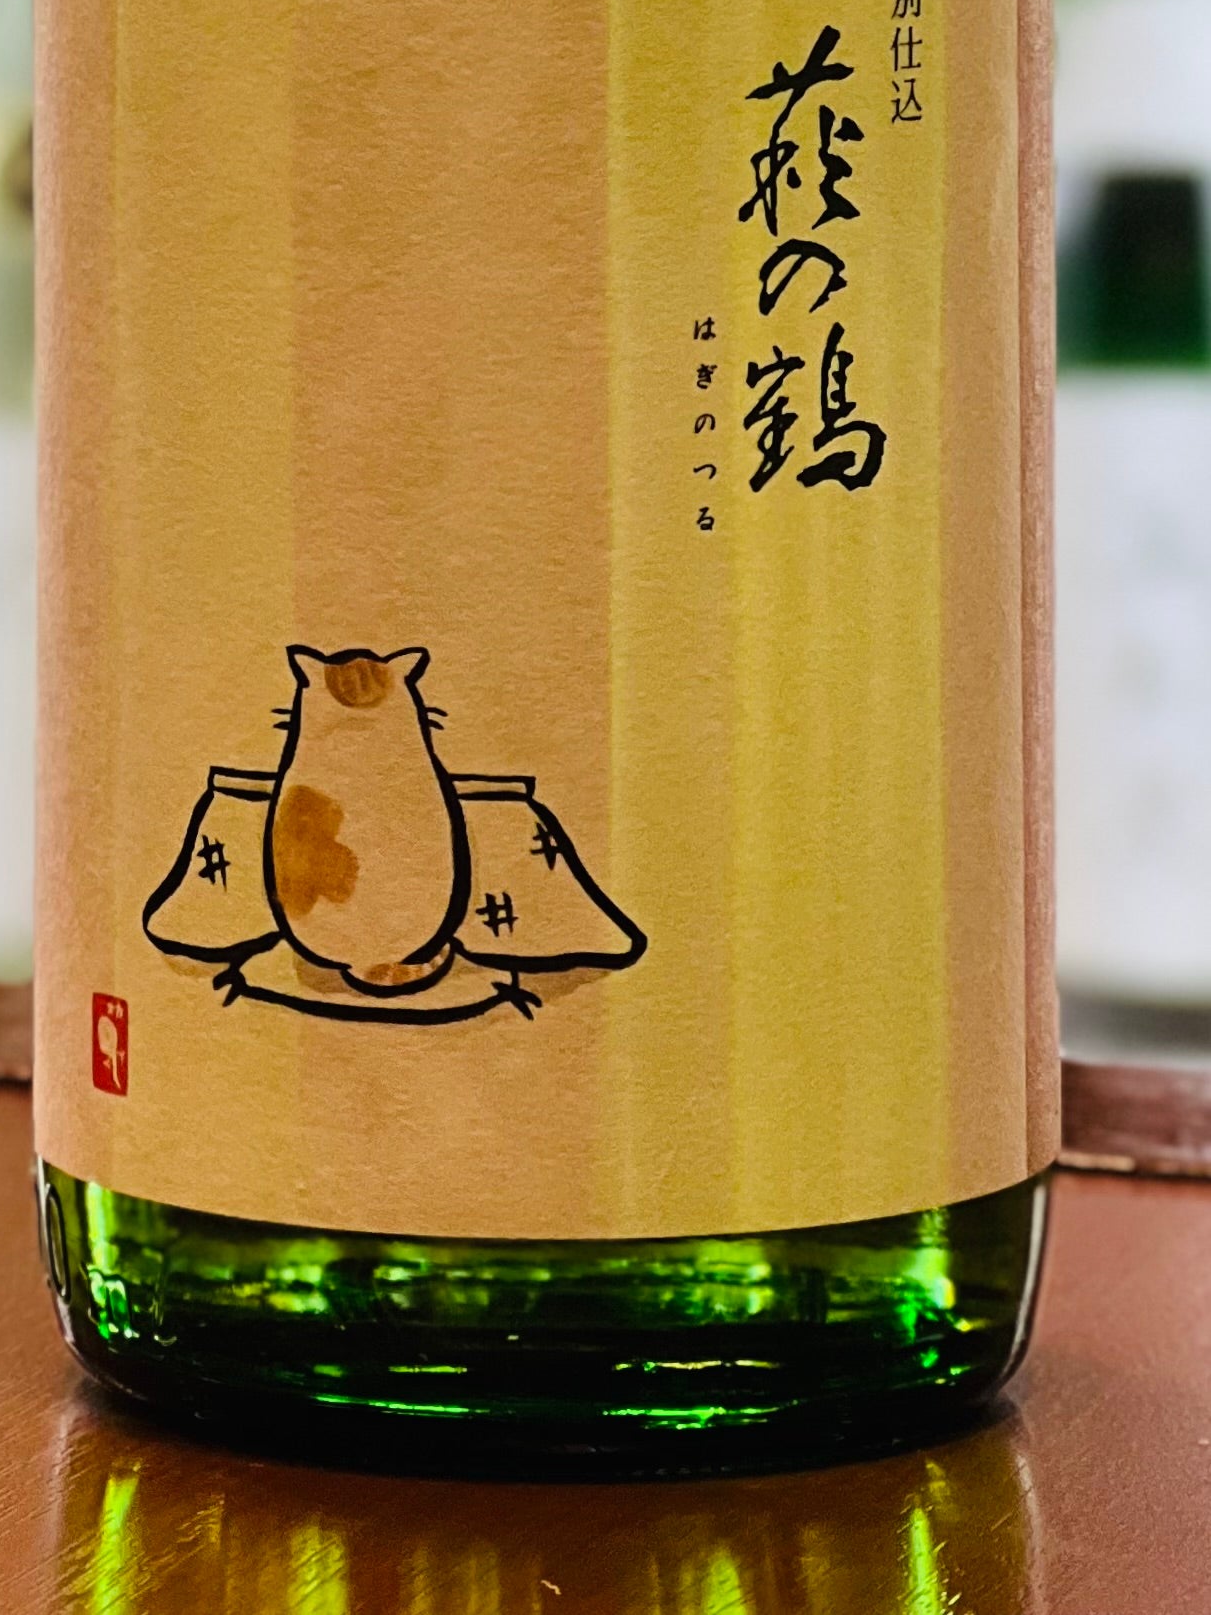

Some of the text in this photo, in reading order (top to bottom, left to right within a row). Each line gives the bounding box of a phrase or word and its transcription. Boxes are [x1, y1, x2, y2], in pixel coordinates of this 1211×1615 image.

[692, 316, 719, 532] はぎのつる
[737, 24, 888, 493] 萩の鶴
